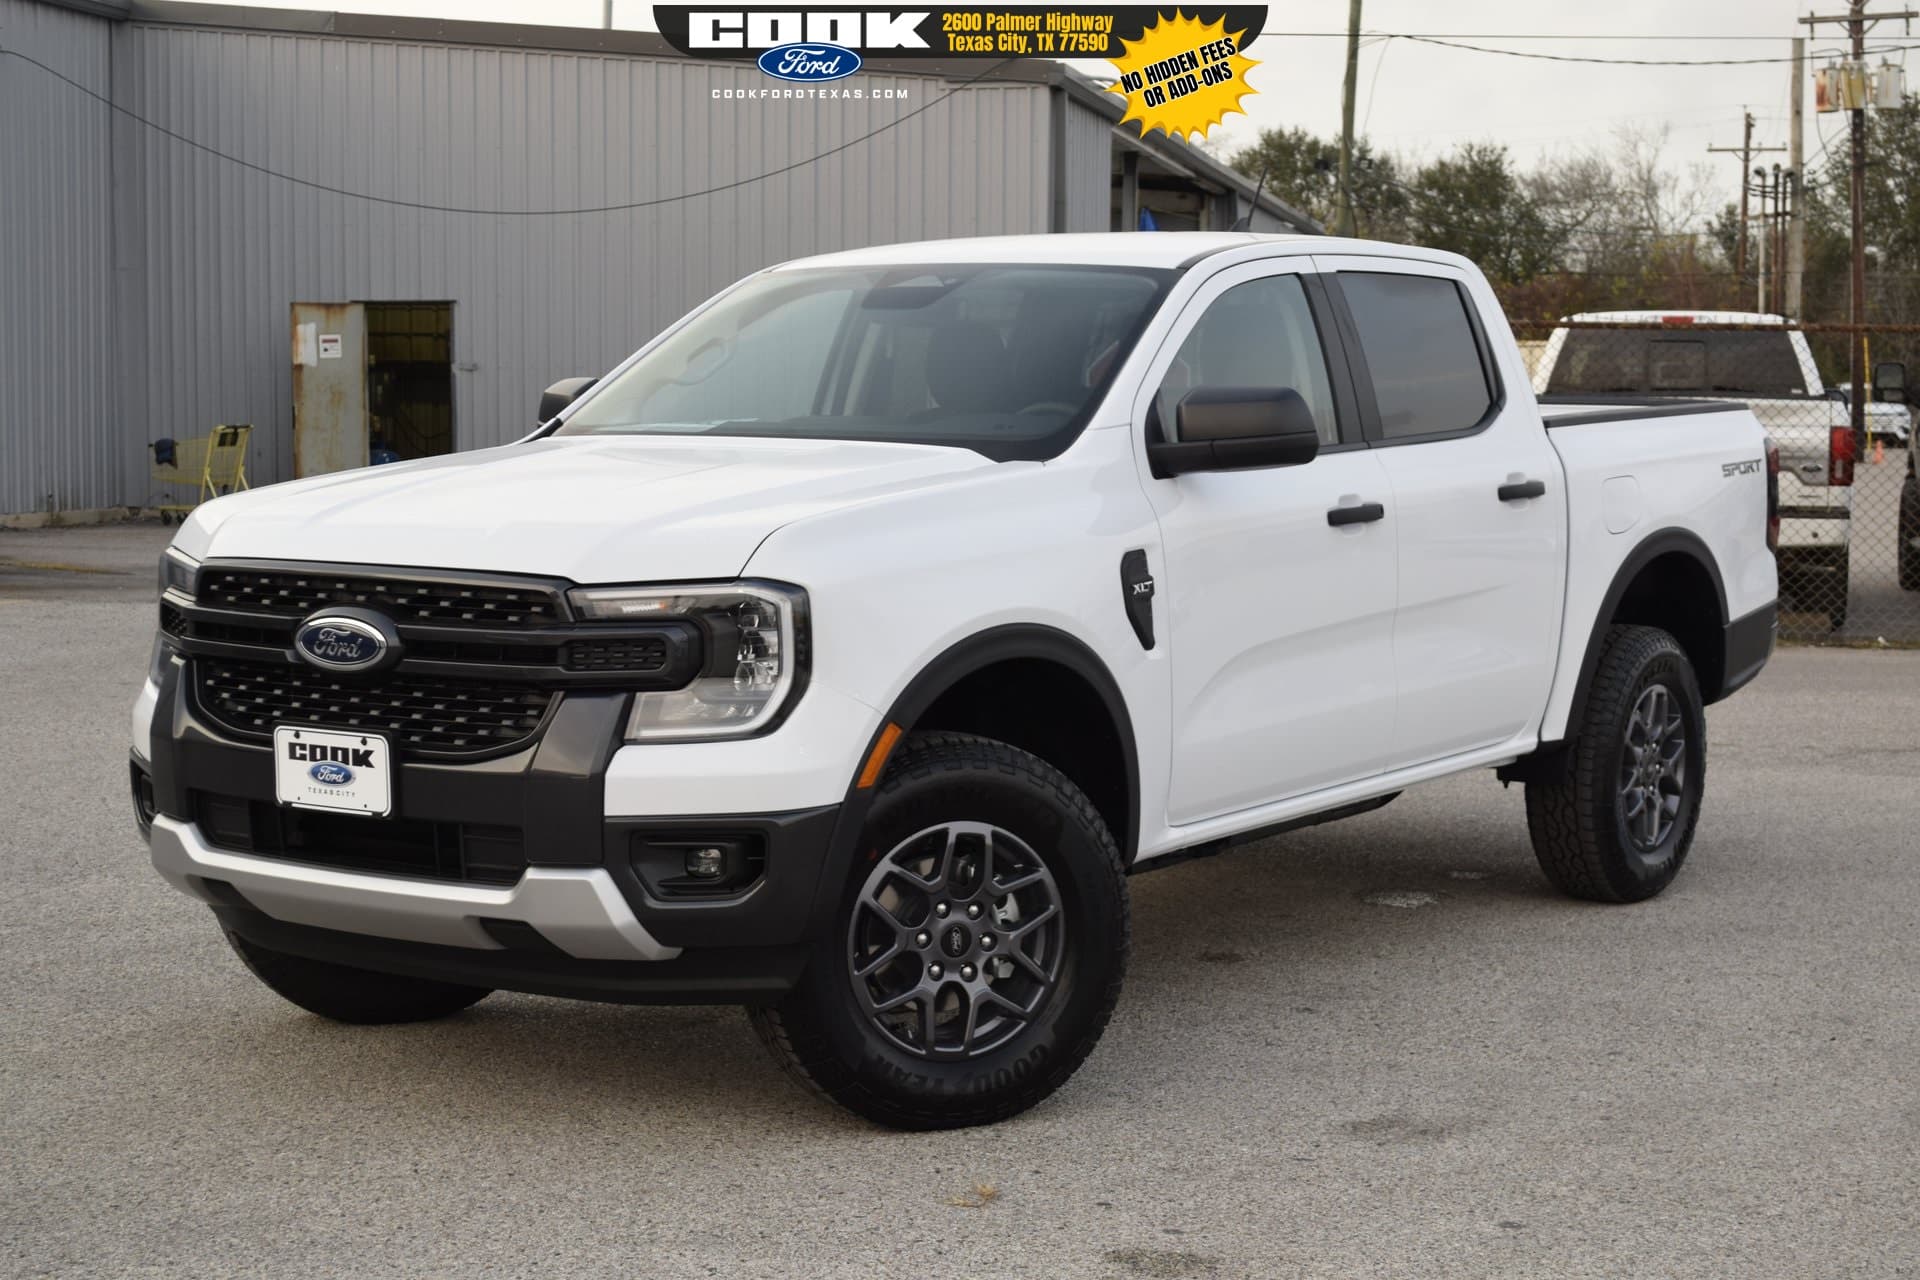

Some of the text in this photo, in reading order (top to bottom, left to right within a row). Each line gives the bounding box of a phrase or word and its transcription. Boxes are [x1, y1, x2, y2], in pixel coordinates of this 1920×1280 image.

[1721, 458, 1762, 478] SPORT
[1132, 580, 1153, 595] XLT
[313, 627, 363, 658] Ford
[288, 741, 375, 768] COOK
[317, 765, 345, 783] Ford
